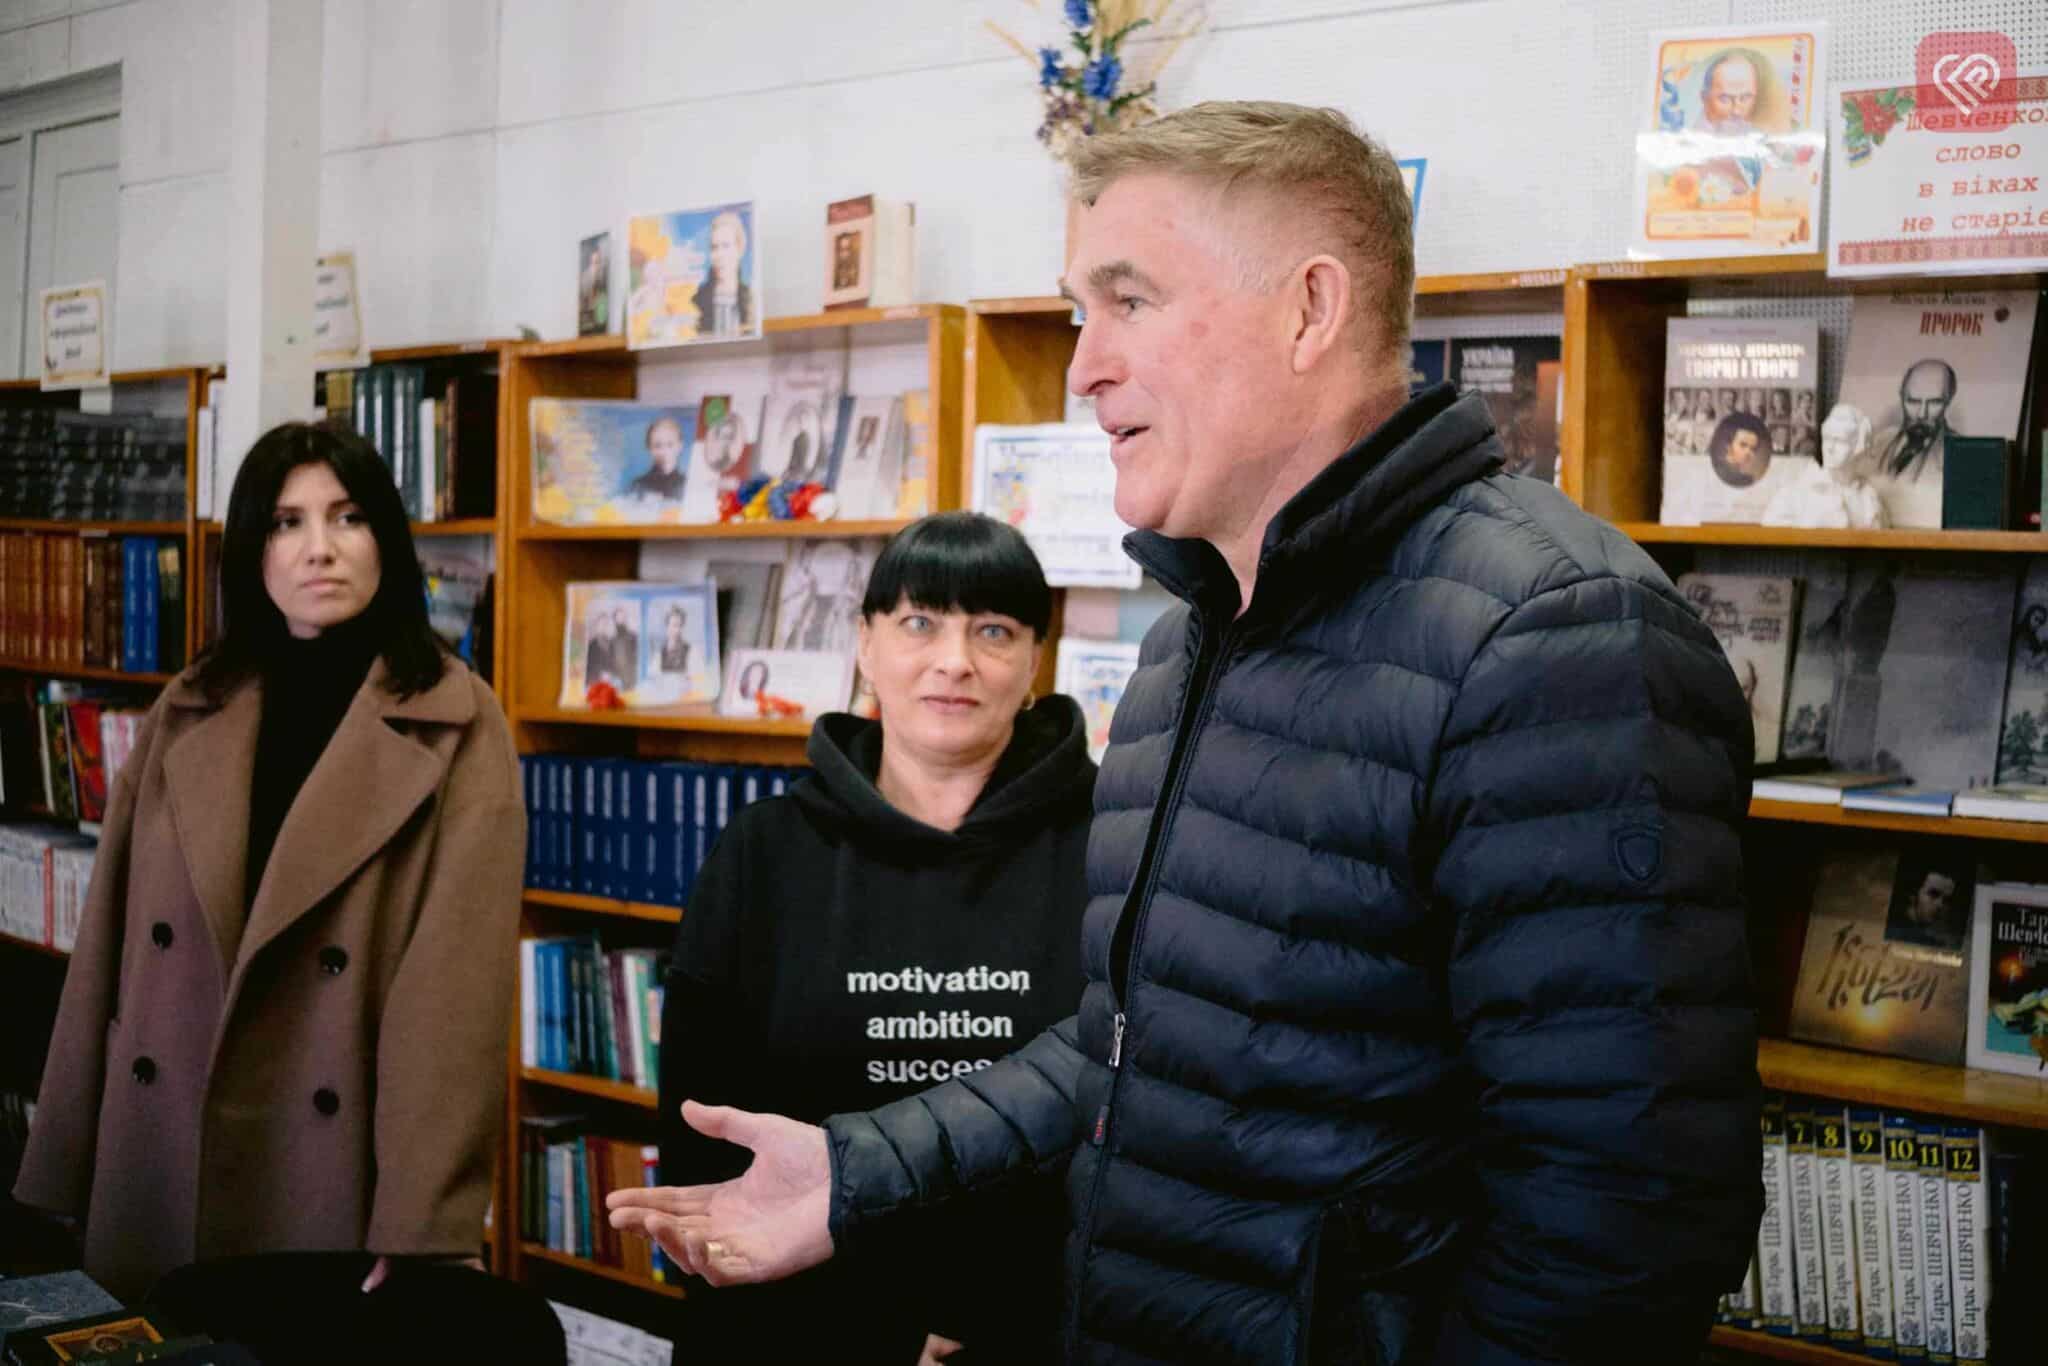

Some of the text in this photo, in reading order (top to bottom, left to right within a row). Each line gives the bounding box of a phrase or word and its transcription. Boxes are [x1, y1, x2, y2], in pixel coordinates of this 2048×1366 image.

[1906, 108, 2048, 131] Шевченко
[1936, 143, 2021, 163] слово
[1918, 174, 2039, 198] в віках
[1902, 216, 1934, 232] не
[1920, 311, 1984, 336] ПРОРОК
[847, 966, 1030, 994] motivation
[866, 1010, 1013, 1039] ambition
[1792, 1121, 1806, 1143] 7
[1823, 1125, 1838, 1148] 8
[1859, 1129, 1873, 1152] 9
[1889, 1138, 1914, 1160] 10
[1920, 1147, 1939, 1166] 11
[1952, 1150, 1975, 1171] 12
[1895, 1173, 1913, 1270] ШЕВЧЕНКО
[1923, 1178, 1943, 1276] ШЕВЧЕНКО
[1956, 1182, 1975, 1281] ШЕВЧЕНКО
